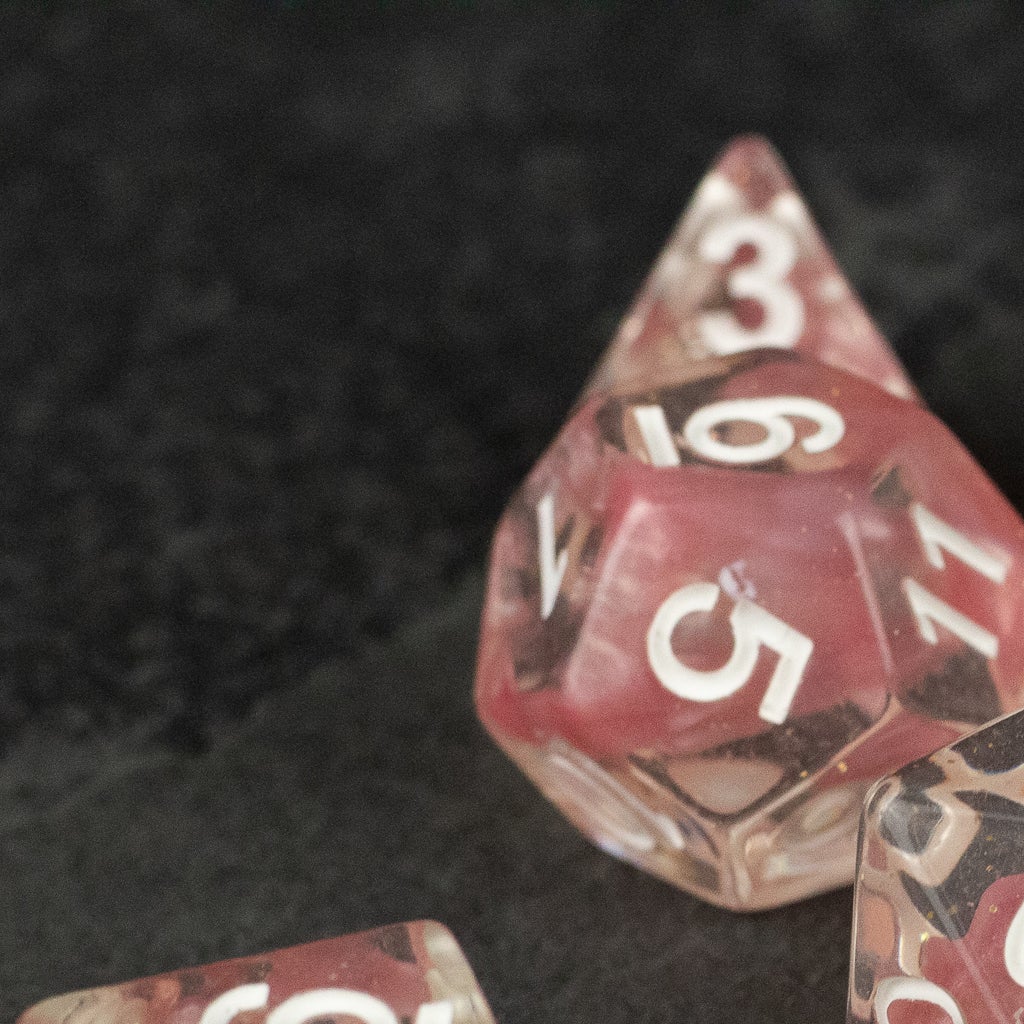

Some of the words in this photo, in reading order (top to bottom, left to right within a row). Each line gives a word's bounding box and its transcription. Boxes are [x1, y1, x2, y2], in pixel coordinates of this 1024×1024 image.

[706, 219, 803, 353] 3
[633, 398, 845, 467] 6
[901, 503, 1011, 658] 11
[647, 583, 814, 724] 5
